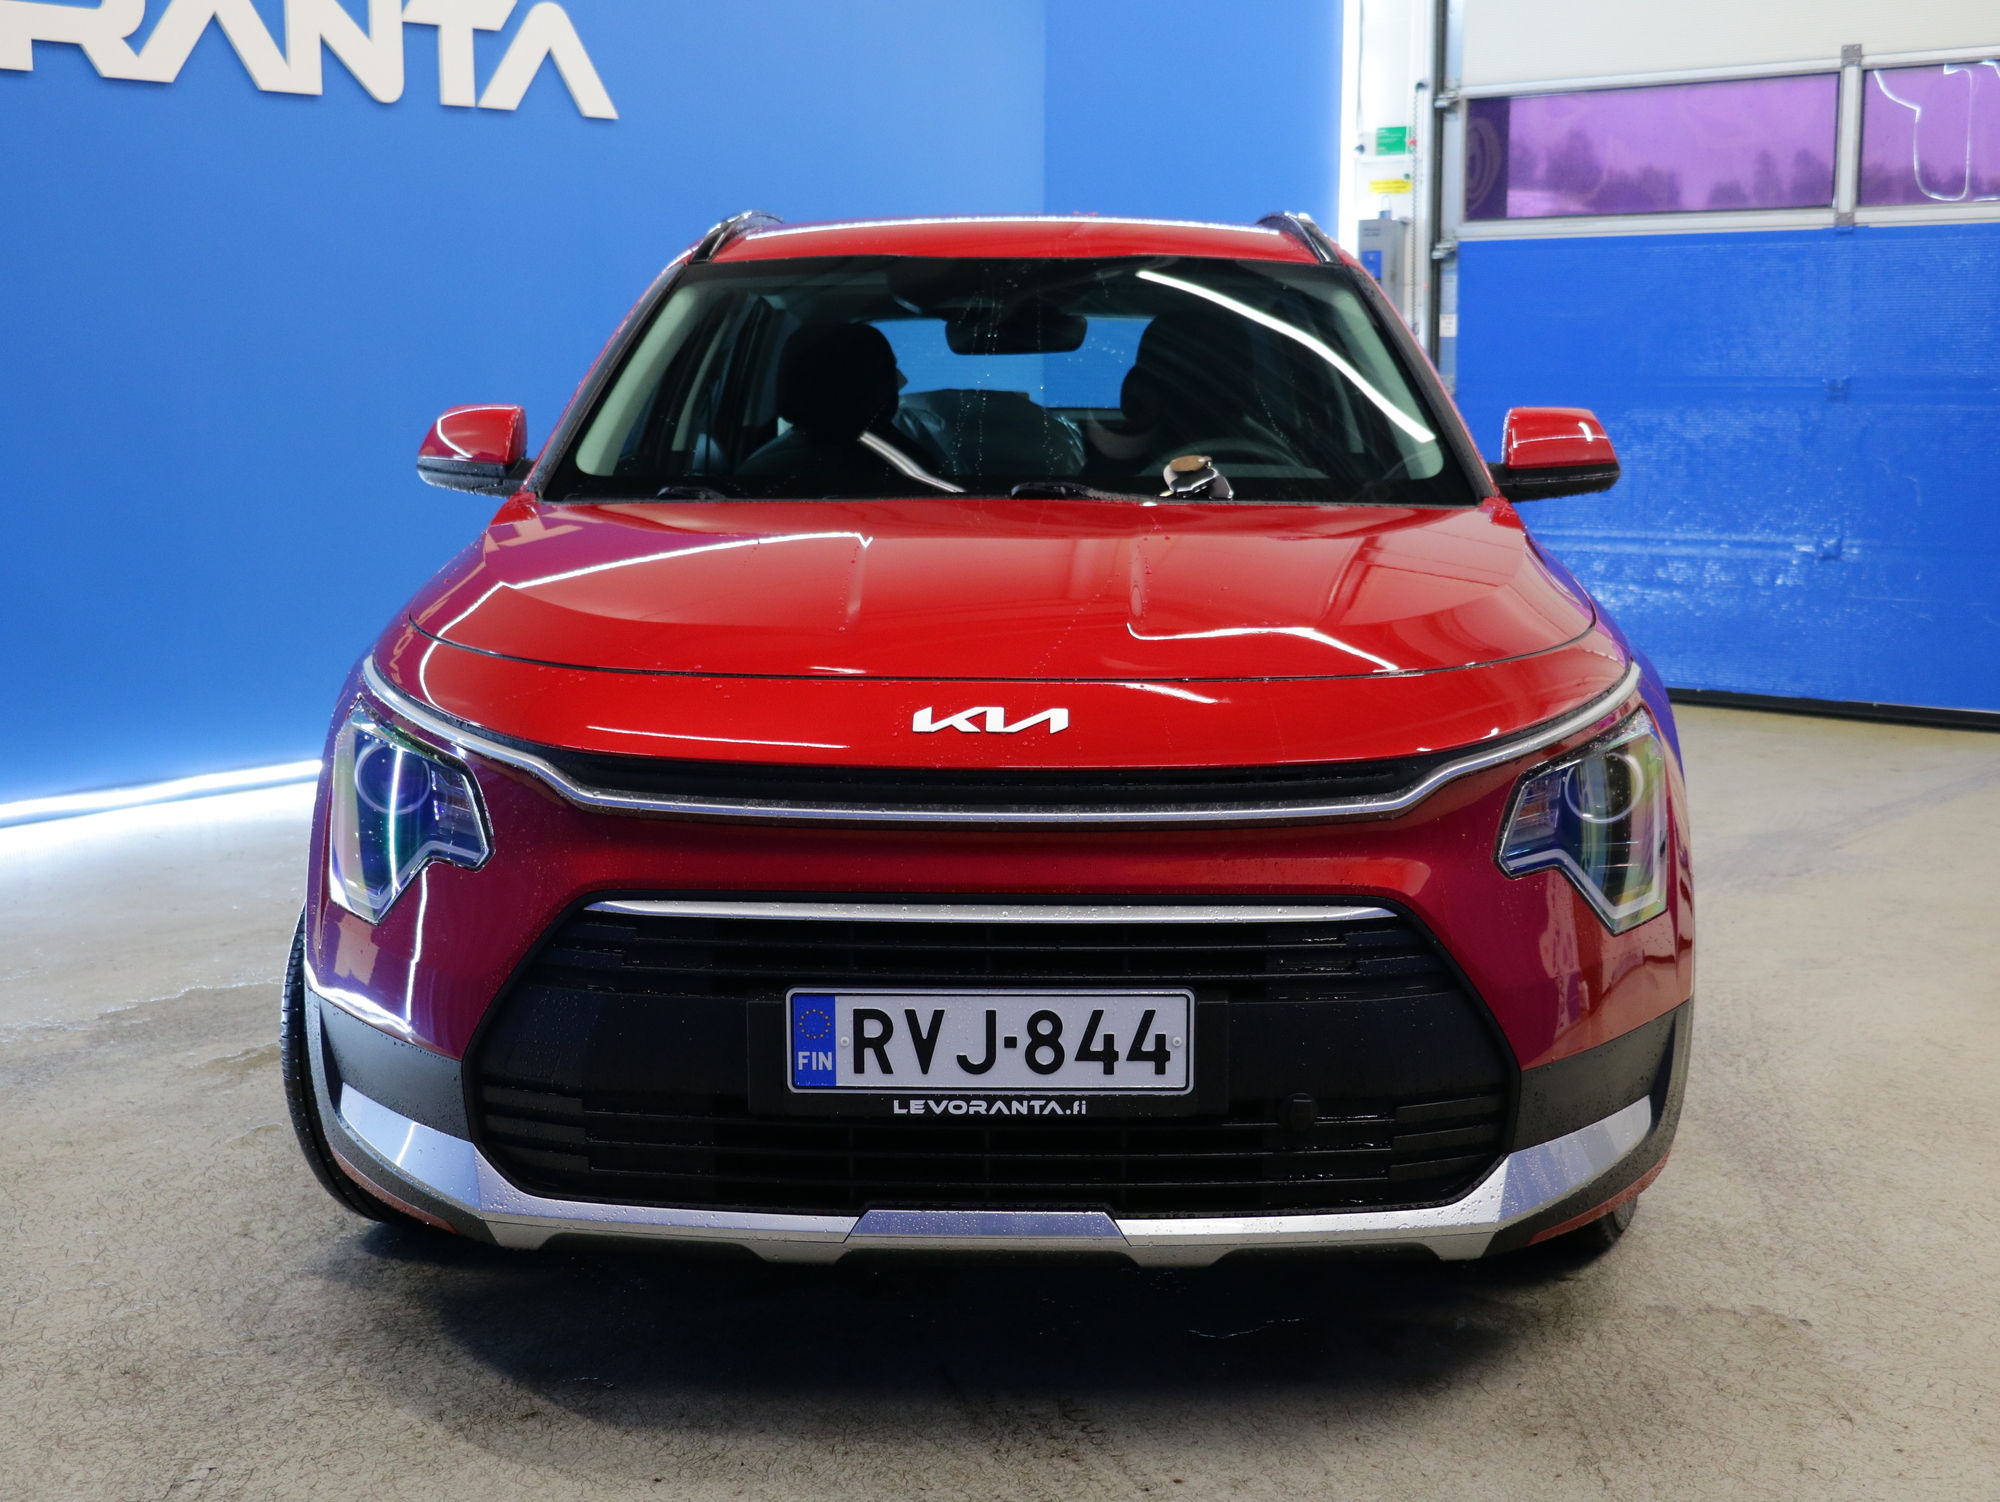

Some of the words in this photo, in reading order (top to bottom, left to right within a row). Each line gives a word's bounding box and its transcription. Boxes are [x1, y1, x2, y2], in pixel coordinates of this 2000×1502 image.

[0, 0, 619, 120] RANTA
[912, 706, 1069, 734] KIA
[852, 1008, 1171, 1075] RVJ-844
[798, 1051, 833, 1071] FIN
[893, 1099, 1087, 1115] LEVORANTA.fi
